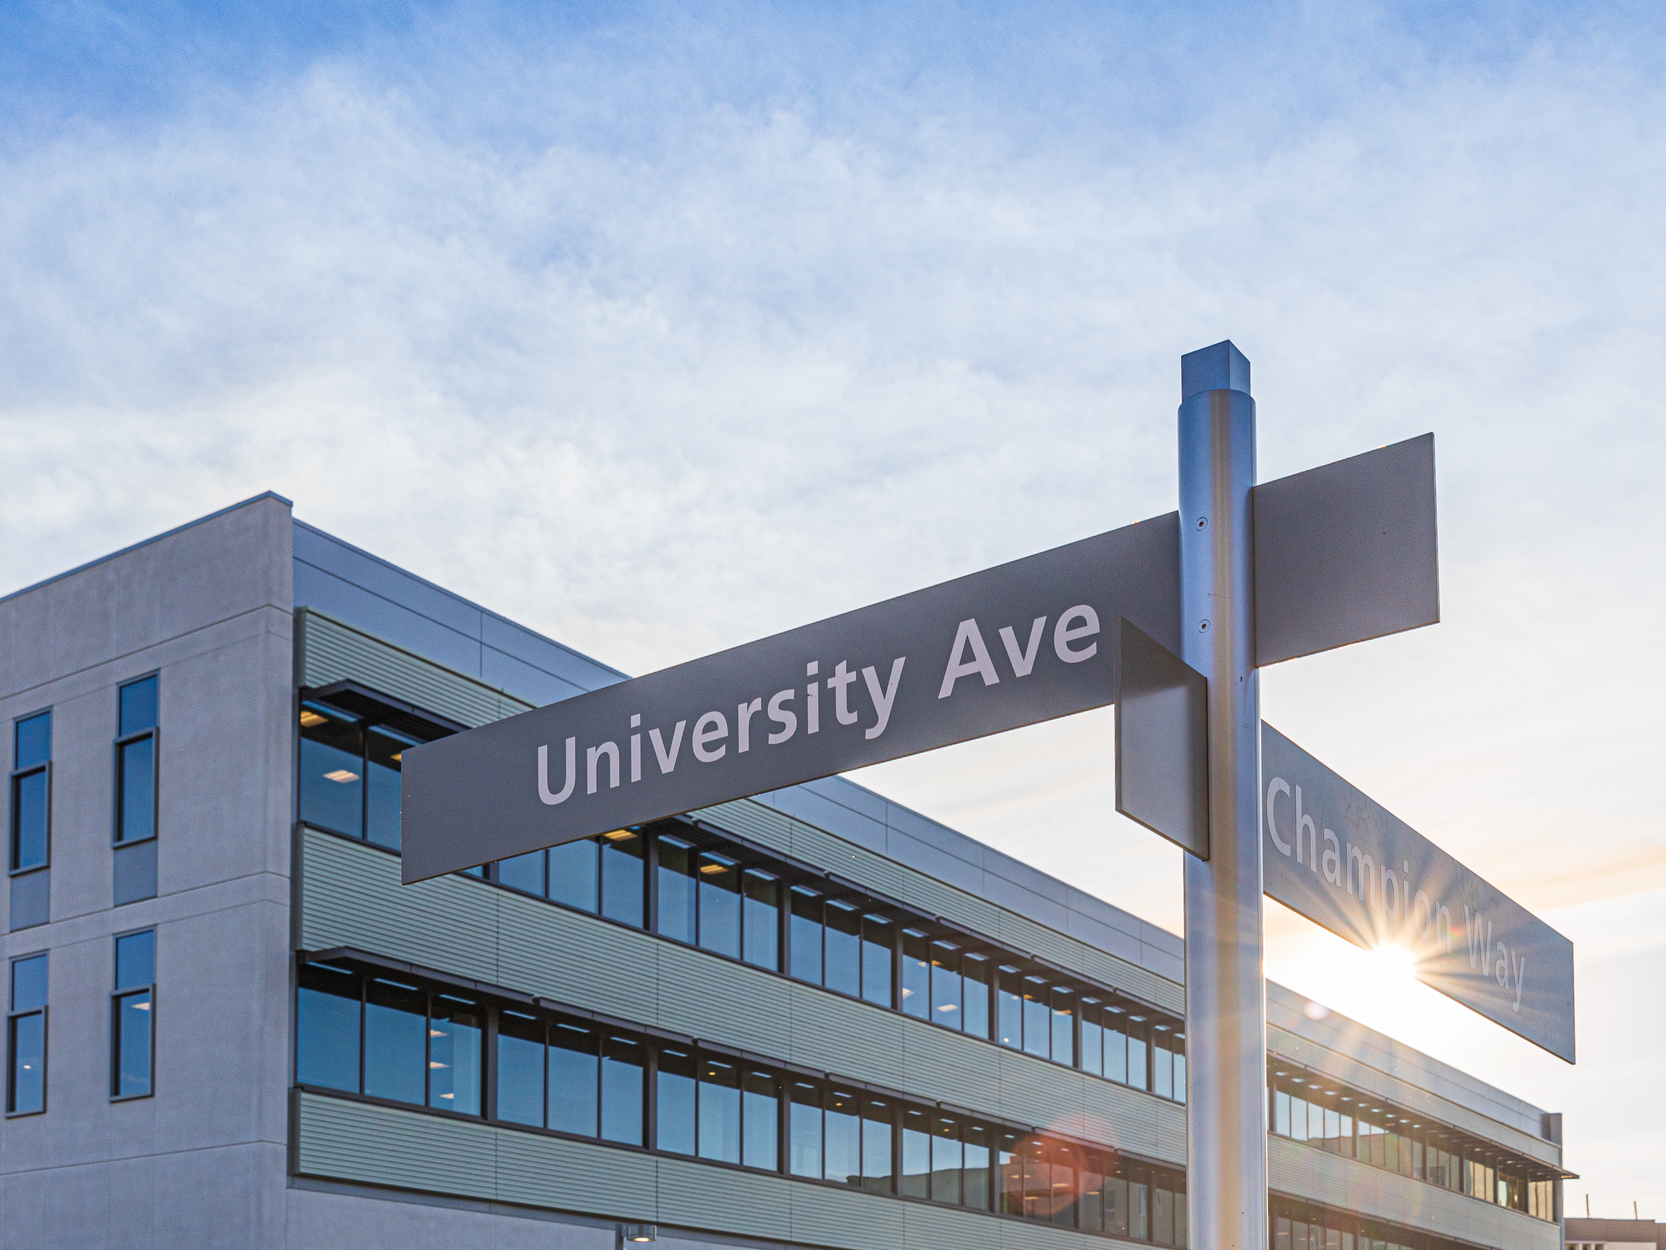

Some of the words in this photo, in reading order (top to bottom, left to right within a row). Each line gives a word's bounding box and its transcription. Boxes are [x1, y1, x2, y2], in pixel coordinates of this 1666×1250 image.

[537, 656, 906, 806] University
[938, 603, 1101, 700] Ave
[1266, 776, 1452, 955] Champion
[1464, 904, 1525, 1012] Way
